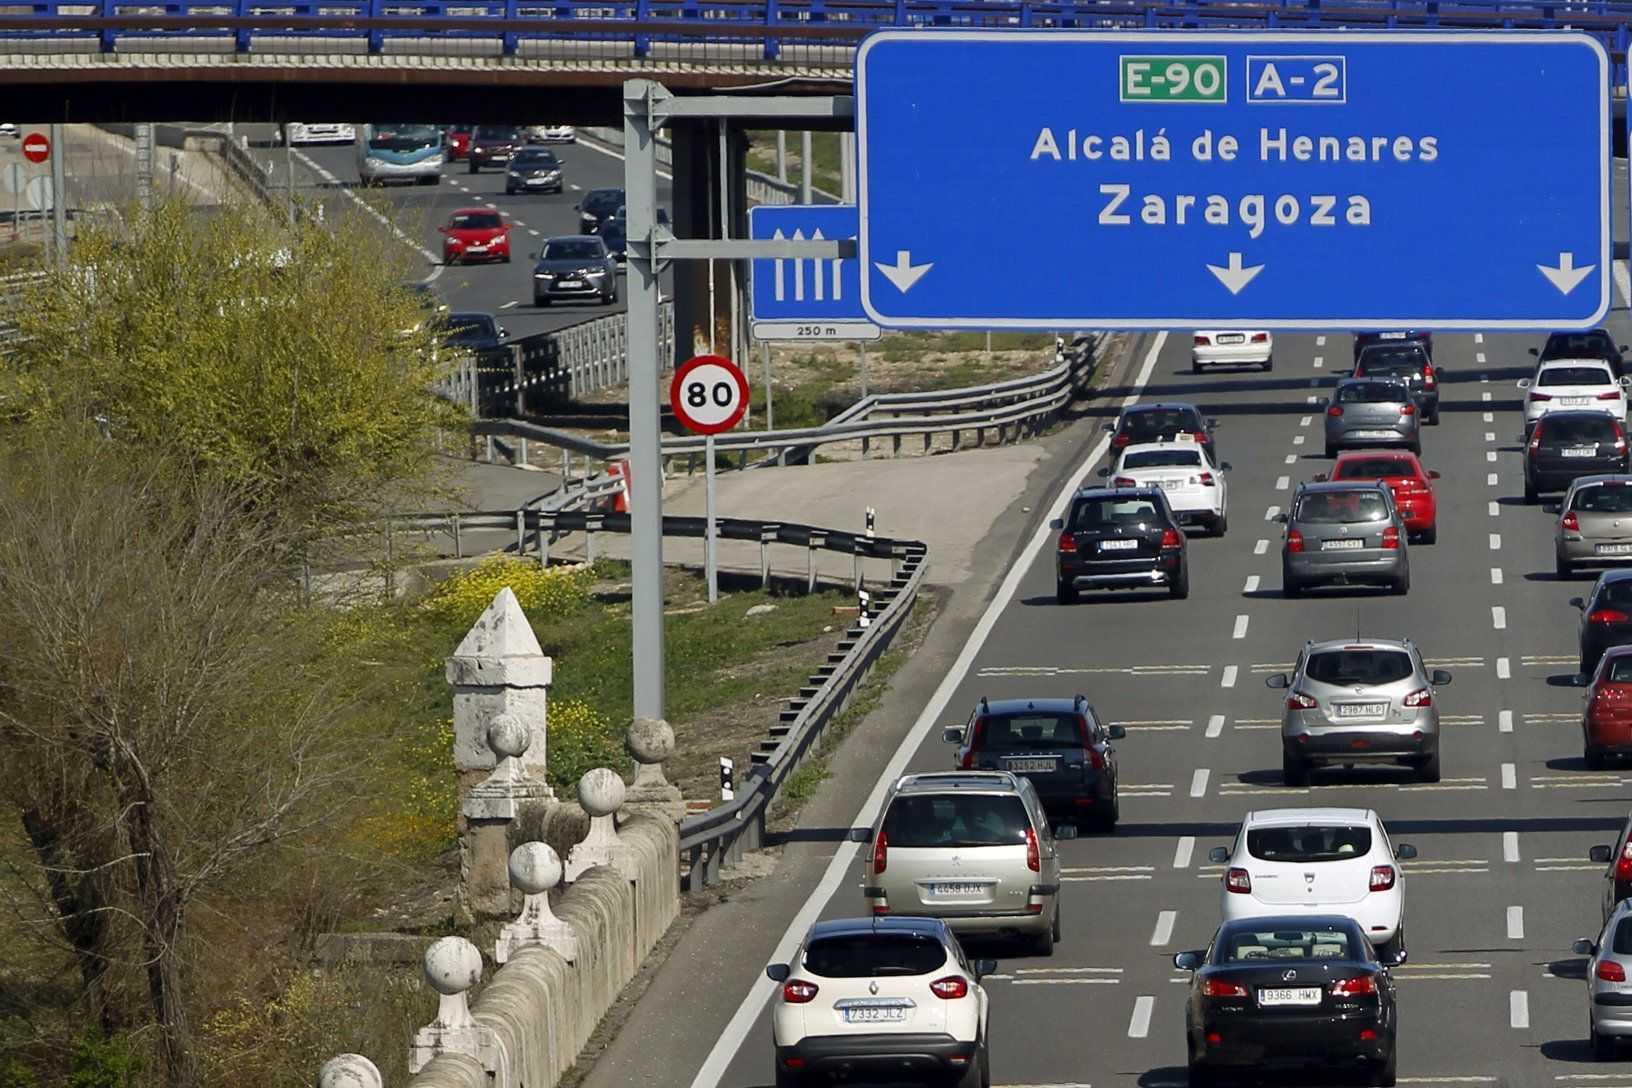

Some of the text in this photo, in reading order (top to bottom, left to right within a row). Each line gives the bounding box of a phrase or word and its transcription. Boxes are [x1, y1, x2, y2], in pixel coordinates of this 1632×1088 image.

[1128, 63, 1338, 96] E-90 A-2
[1031, 128, 1437, 160] Alcalá de Henares
[1099, 184, 1370, 238] Zaragoza
[797, 327, 820, 335] 250
[687, 382, 733, 407] 80
[852, 1006, 880, 1019] 7332
